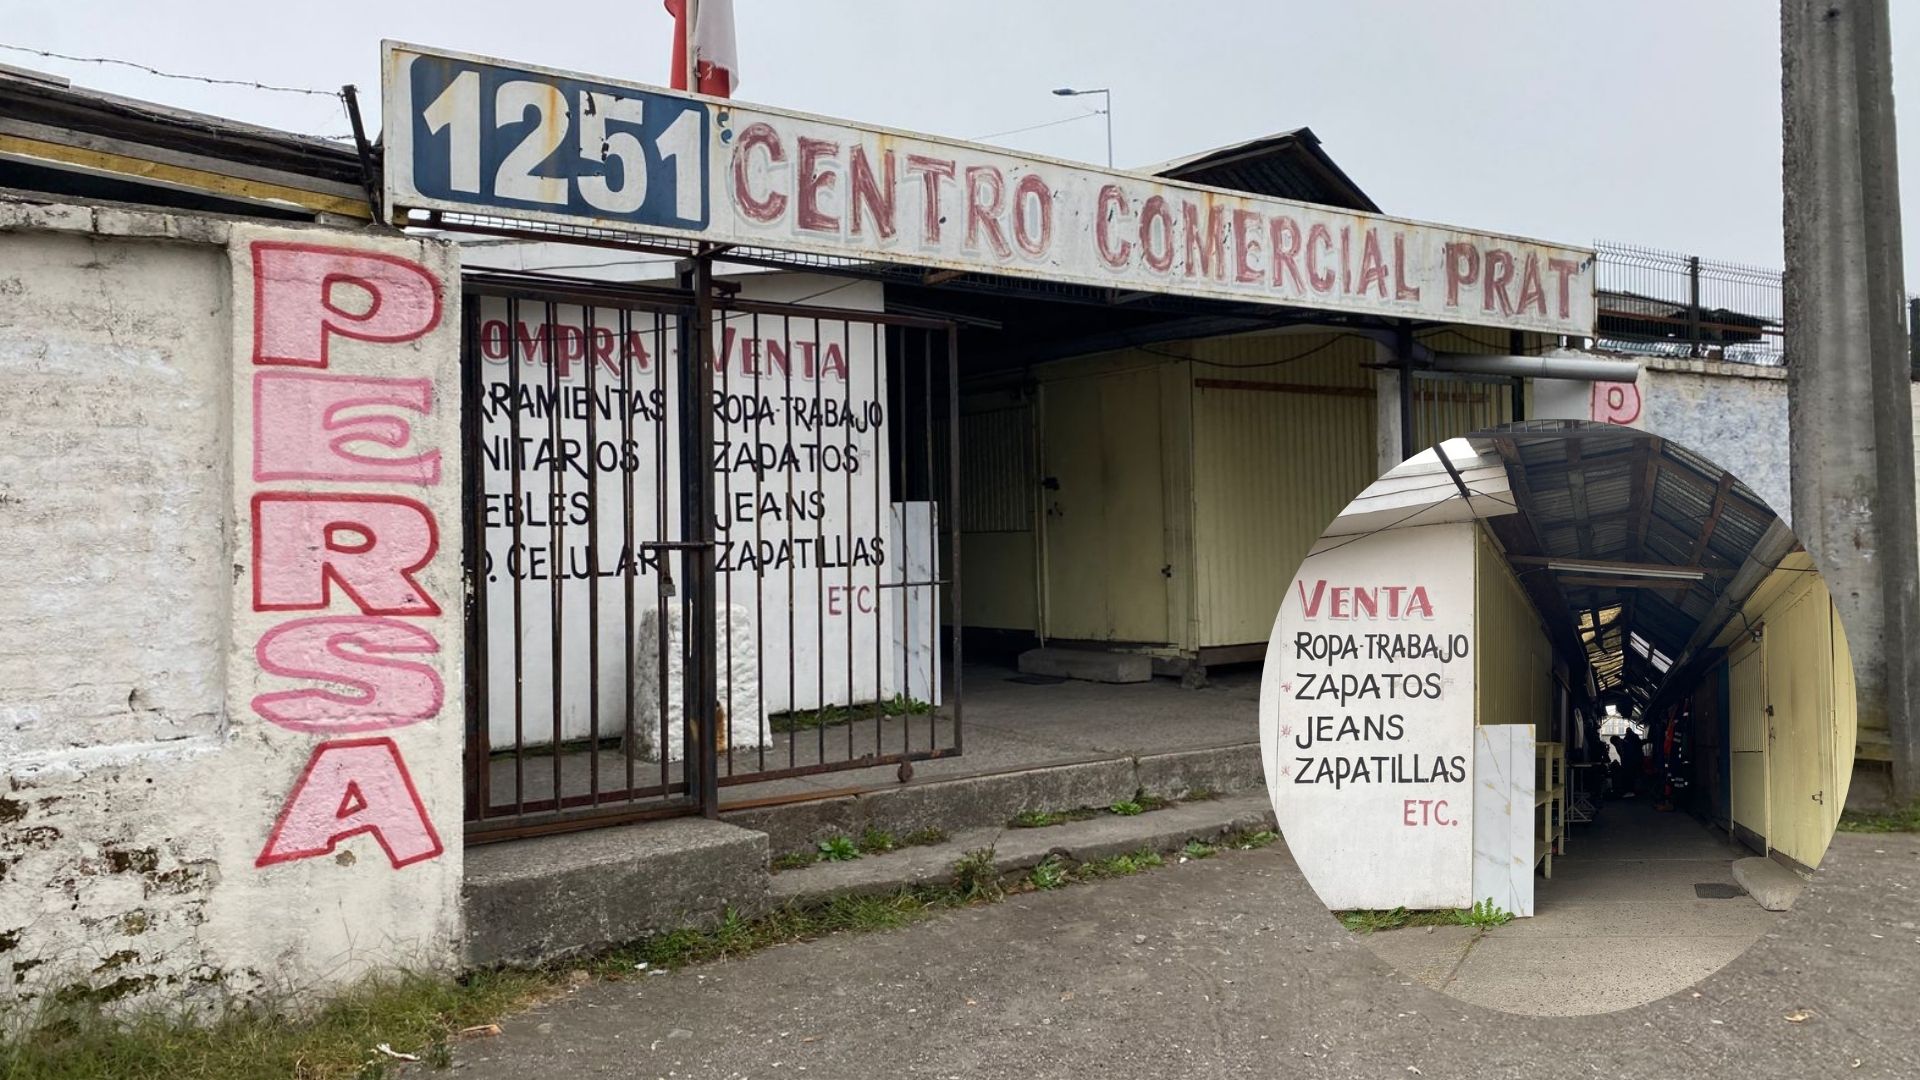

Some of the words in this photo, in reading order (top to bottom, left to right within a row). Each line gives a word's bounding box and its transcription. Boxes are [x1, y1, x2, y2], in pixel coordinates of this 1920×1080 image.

[422, 70, 702, 222] 1251
[1095, 183, 1421, 302] COMERCIAL
[481, 319, 651, 377] OMPRA
[712, 326, 847, 380] VENTA
[481, 381, 665, 424] RRAMIENTAS
[482, 434, 640, 480] NITAROS
[713, 441, 860, 482] ZAPATOS
[484, 491, 592, 529] EBLES
[714, 490, 826, 532] JEANS
[251, 240, 443, 868] PERSA
[714, 534, 885, 579] ZAPATILLAS
[1297, 578, 1434, 621] VENTA
[1294, 631, 1469, 667] ROPA-TRABAJO
[1294, 672, 1442, 707] ZAPATOS
[1295, 713, 1405, 749] JEANS
[1294, 753, 1466, 790] ZAPATILLAS
[1403, 799, 1459, 827] ETC.
